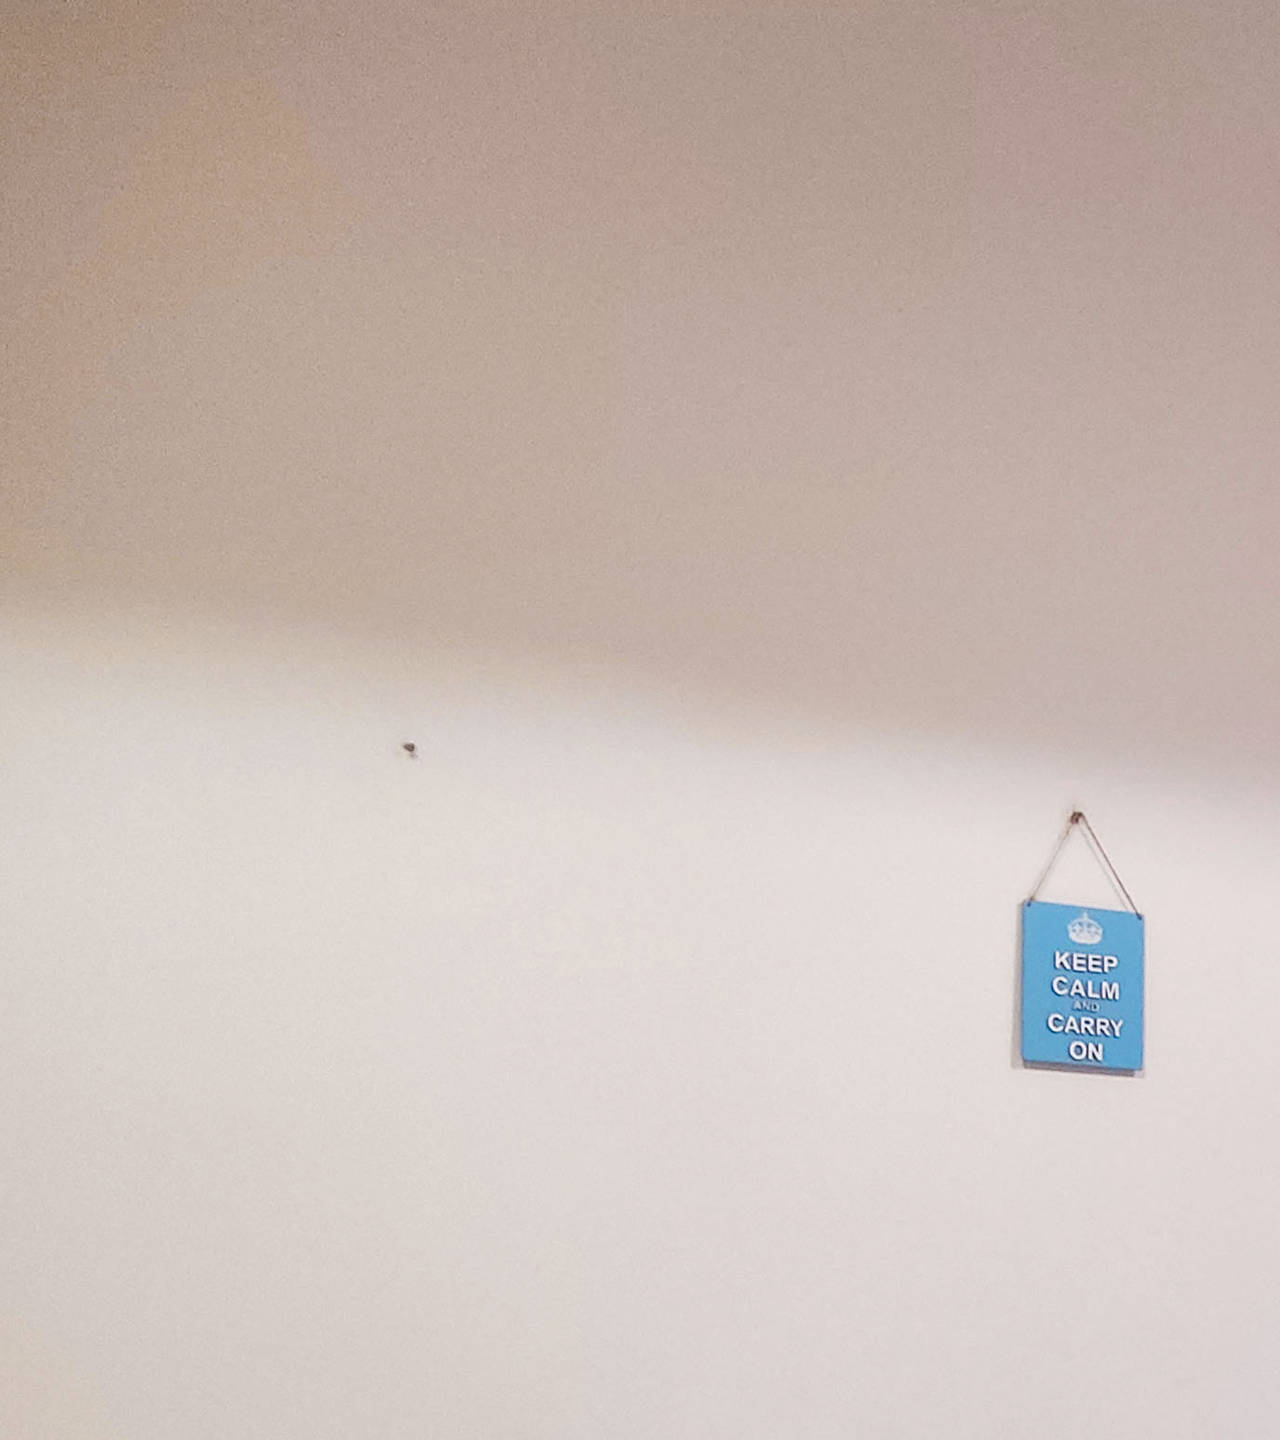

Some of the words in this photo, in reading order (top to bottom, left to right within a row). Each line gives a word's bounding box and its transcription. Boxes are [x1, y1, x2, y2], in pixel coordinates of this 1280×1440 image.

[1054, 951, 1118, 973] KEEP
[1052, 976, 1119, 1000] CALM
[1073, 1000, 1100, 1012] AND
[1048, 1013, 1123, 1037] CARRY
[1069, 1041, 1103, 1061] ON
